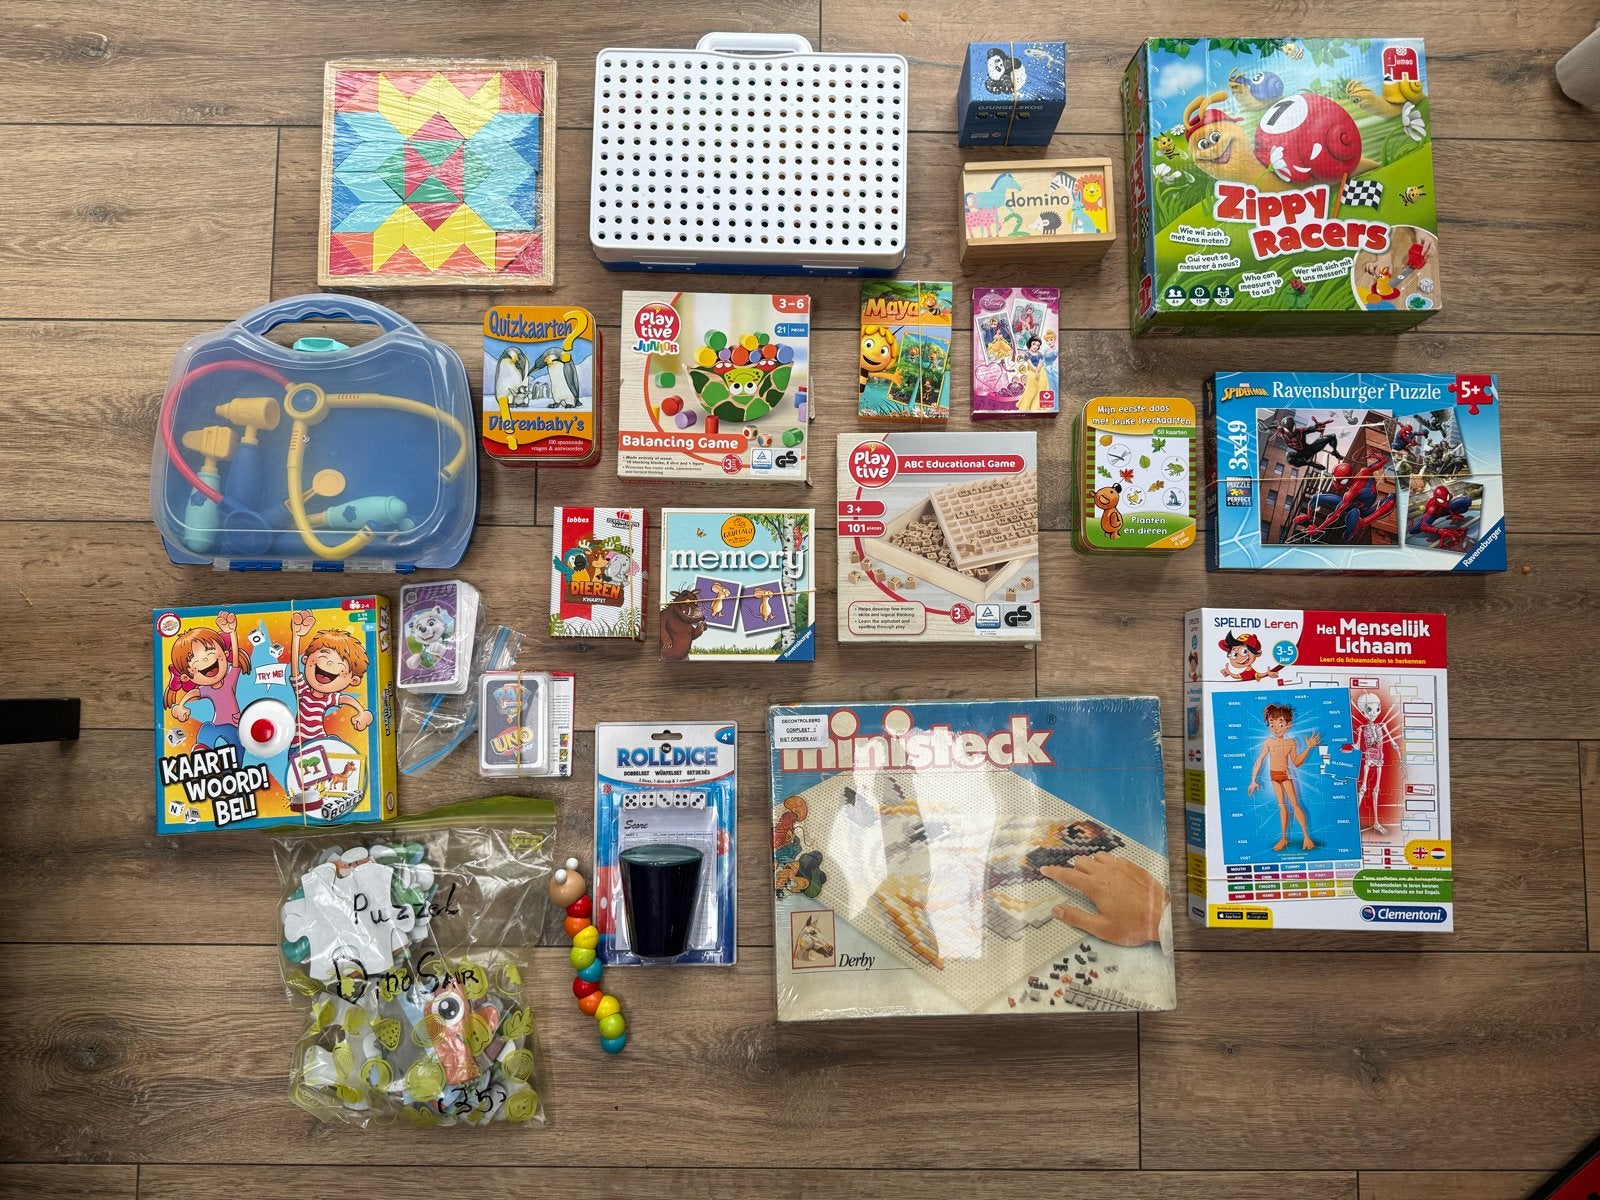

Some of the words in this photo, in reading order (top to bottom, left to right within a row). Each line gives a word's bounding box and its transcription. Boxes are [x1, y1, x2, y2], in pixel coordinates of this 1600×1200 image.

[1005, 192, 1070, 207] domino
[1216, 184, 1328, 227] Zippy
[1252, 223, 1388, 259] Racers
[1201, 254, 1218, 262] veut
[1311, 265, 1323, 273] will
[1324, 263, 1338, 271] sich
[1317, 267, 1347, 280] messen?
[1240, 281, 1271, 290] measure
[865, 298, 919, 320] Maya
[640, 311, 674, 328] Play
[641, 324, 672, 338] tive
[633, 340, 677, 353] JUNIOR
[1272, 381, 1384, 403] Ravensburger
[1389, 382, 1442, 400] Puzzle
[1460, 380, 1480, 398] 5+
[1097, 406, 1115, 415] Mijn
[1092, 417, 1109, 425] met
[622, 435, 695, 450] Balancing
[698, 437, 739, 449] Game
[1227, 420, 1248, 470] 3x49
[854, 451, 891, 467] Play
[904, 460, 924, 469] ABC
[926, 460, 985, 469] Educational
[987, 460, 1016, 468] Game
[855, 465, 890, 479] tive
[847, 504, 863, 514] 3+
[1131, 516, 1166, 524] Planten
[847, 524, 866, 533] 101
[1138, 527, 1167, 535] dieren
[1462, 526, 1503, 568] Ravensburger
[669, 549, 805, 579] memory
[571, 581, 620, 599] DIEREN
[1214, 617, 1261, 628] SPELEND
[1264, 618, 1298, 629] Leren
[1316, 624, 1337, 635] Het
[1340, 618, 1430, 638] Menselijk
[783, 628, 813, 659] Ravensburger
[1276, 645, 1294, 656] 3-5
[1335, 636, 1412, 654] Lichaam
[272, 669, 284, 678] ME!
[490, 726, 534, 754] UNO
[721, 733, 731, 741] 4+
[673, 746, 718, 767] DICE
[162, 746, 238, 784] KAART!
[186, 765, 269, 801] WOORD!
[215, 793, 257, 826] BEL!
[624, 820, 648, 829] Score
[1378, 908, 1441, 920] Clementoni
[839, 952, 875, 971] Derby
